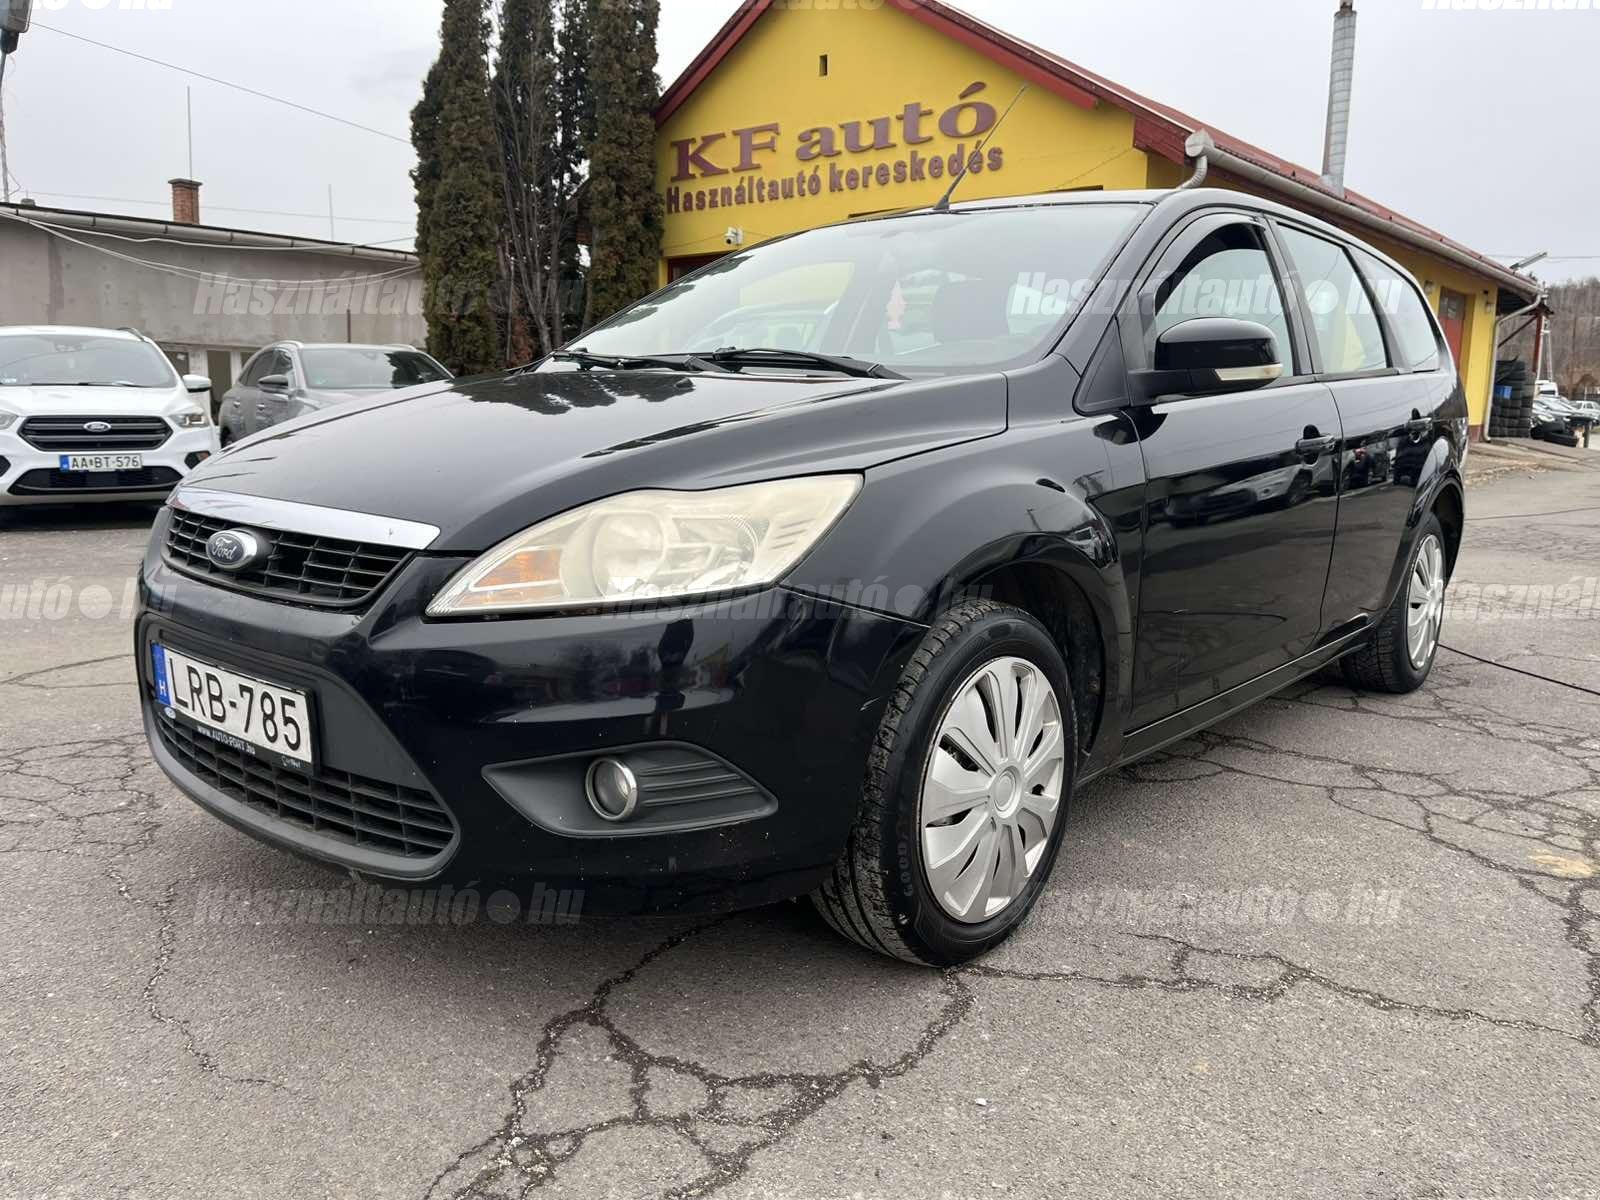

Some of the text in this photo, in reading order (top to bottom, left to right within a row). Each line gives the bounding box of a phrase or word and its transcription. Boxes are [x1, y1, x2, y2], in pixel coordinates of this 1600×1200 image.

[670, 81, 997, 183] KF autó
[666, 139, 1004, 214] Használtautó kereskedés
[211, 537, 238, 560] Ford
[169, 657, 302, 751] LRB-785
